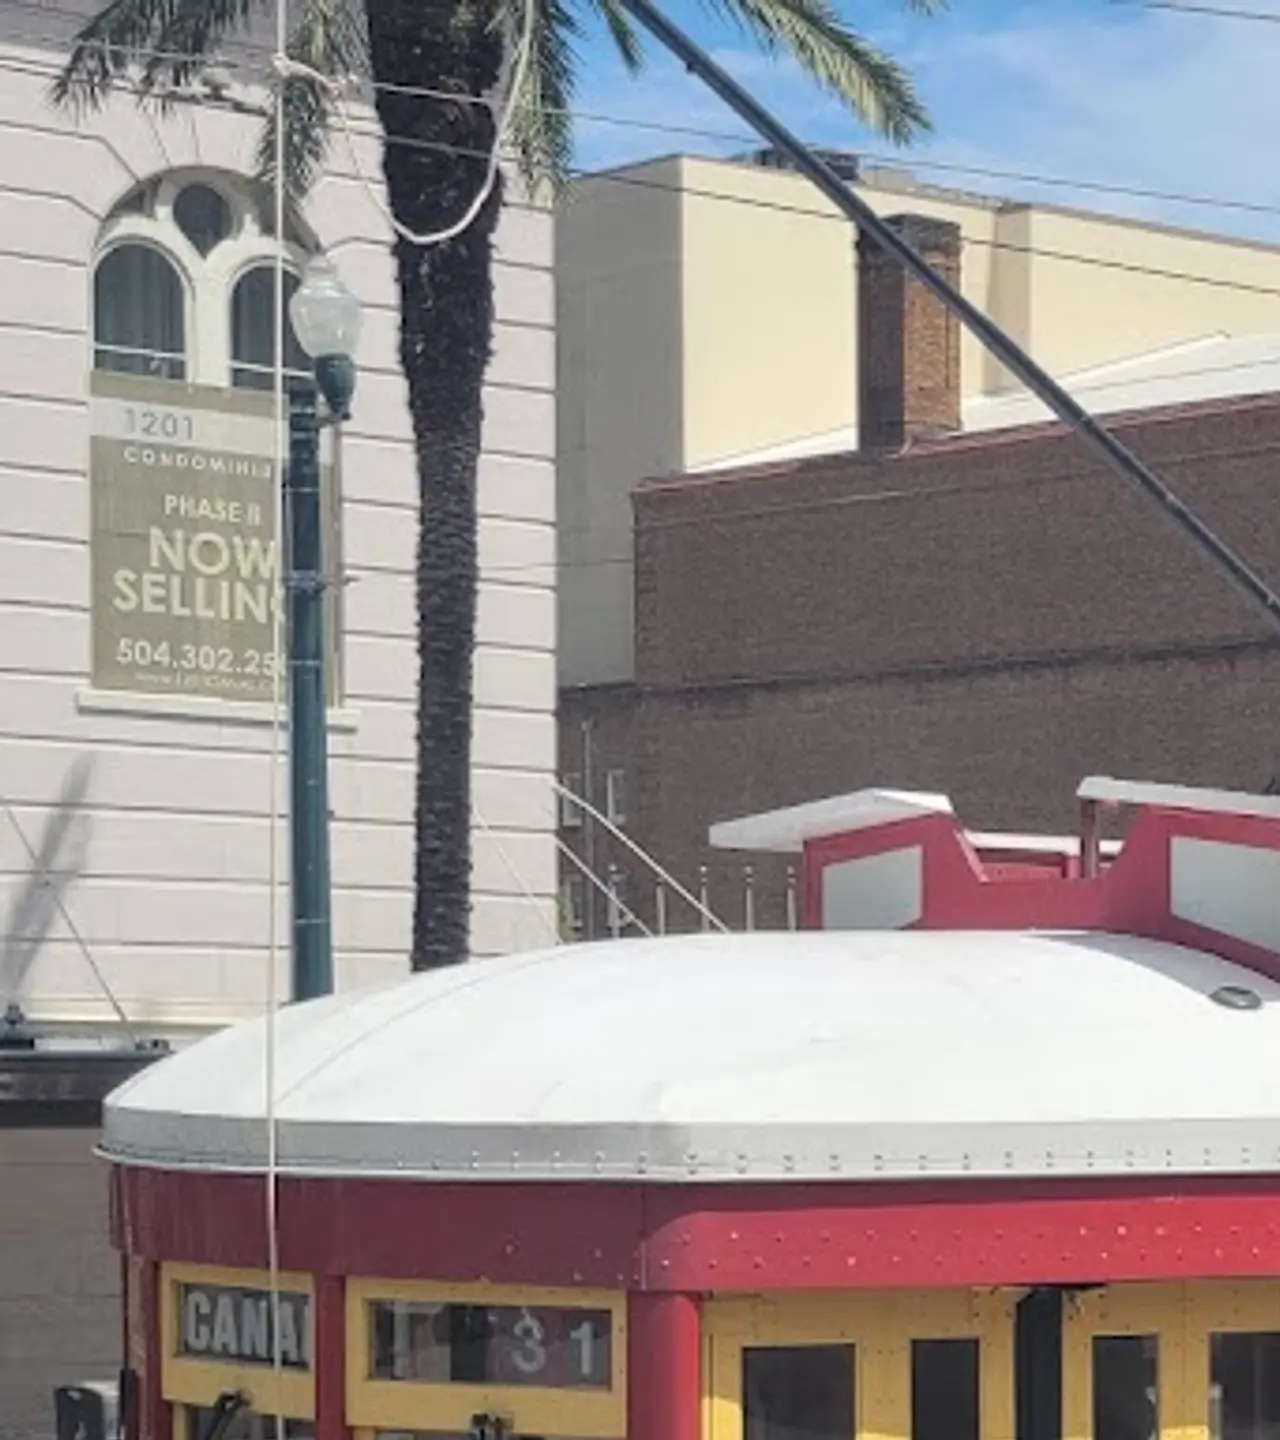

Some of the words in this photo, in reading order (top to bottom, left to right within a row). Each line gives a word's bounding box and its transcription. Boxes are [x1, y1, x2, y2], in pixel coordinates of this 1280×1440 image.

[124, 409, 194, 440] 1201
[164, 494, 242, 524] PHASE
[150, 525, 276, 579] NOW
